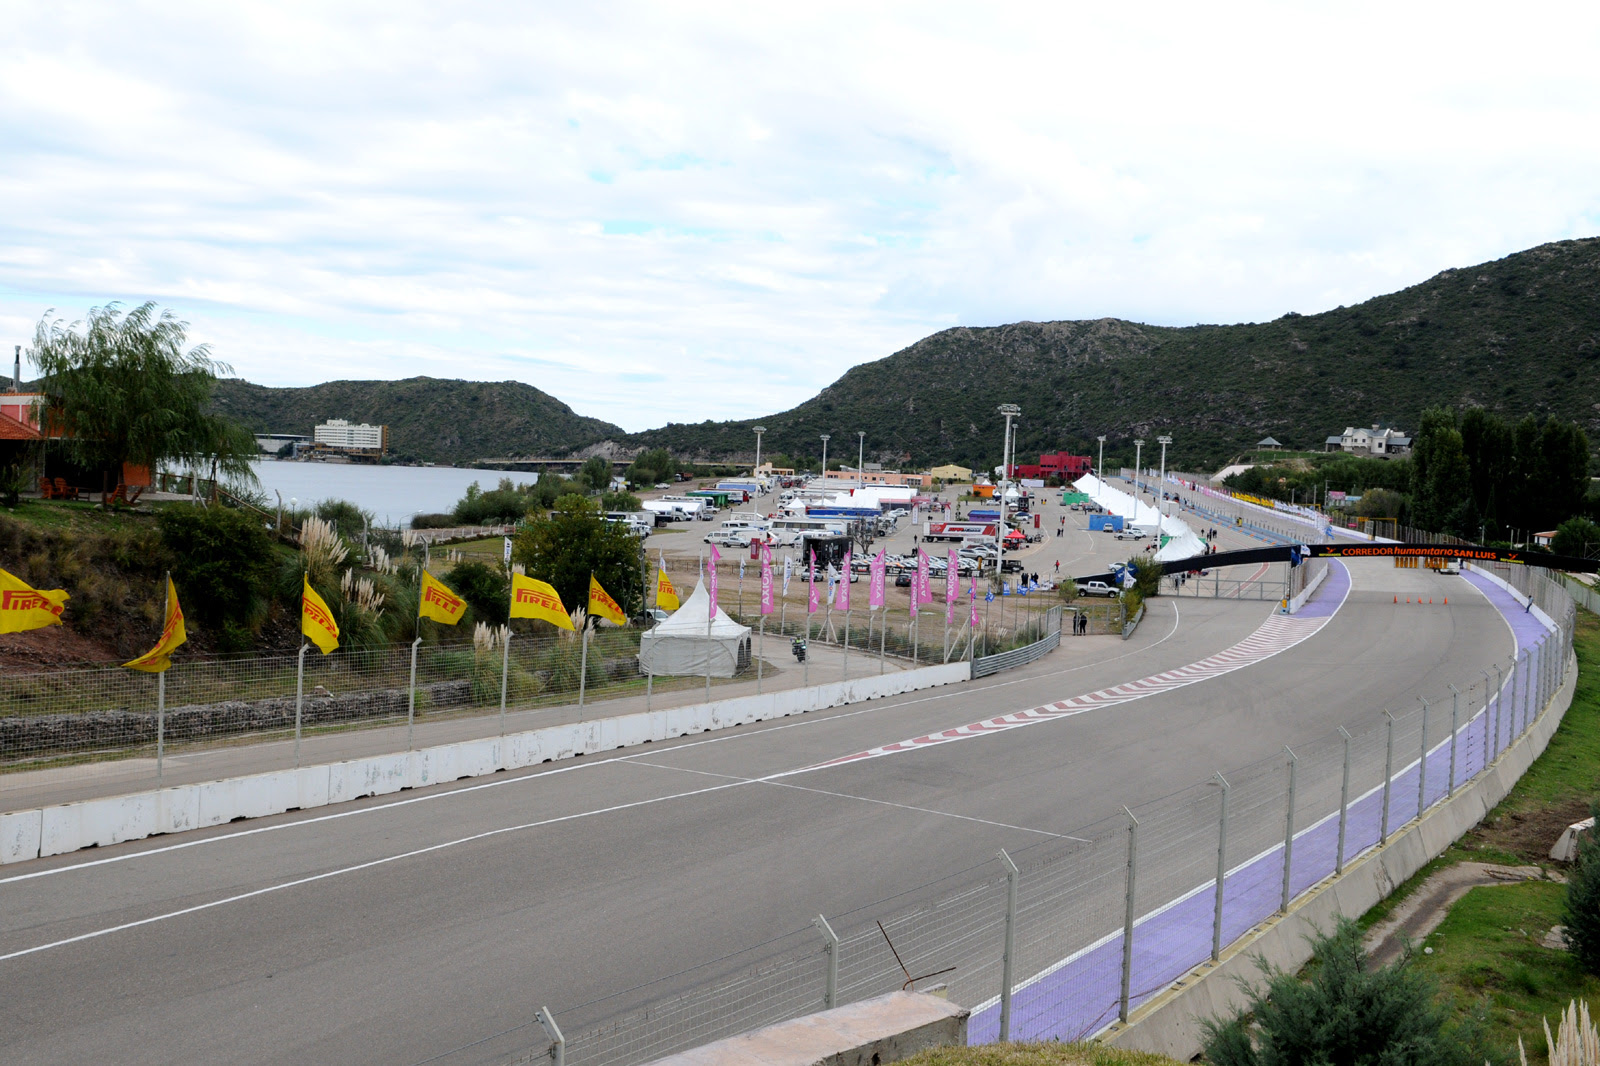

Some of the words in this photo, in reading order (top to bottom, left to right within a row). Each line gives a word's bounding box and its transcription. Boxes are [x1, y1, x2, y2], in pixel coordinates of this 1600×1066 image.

[1342, 547, 1393, 556] CORREDOR
[1393, 546, 1453, 556] humanitario
[1453, 549, 1474, 557] SAN
[1475, 551, 1496, 559] LUIS
[762, 567, 770, 606] AXION
[947, 567, 955, 597] AXION
